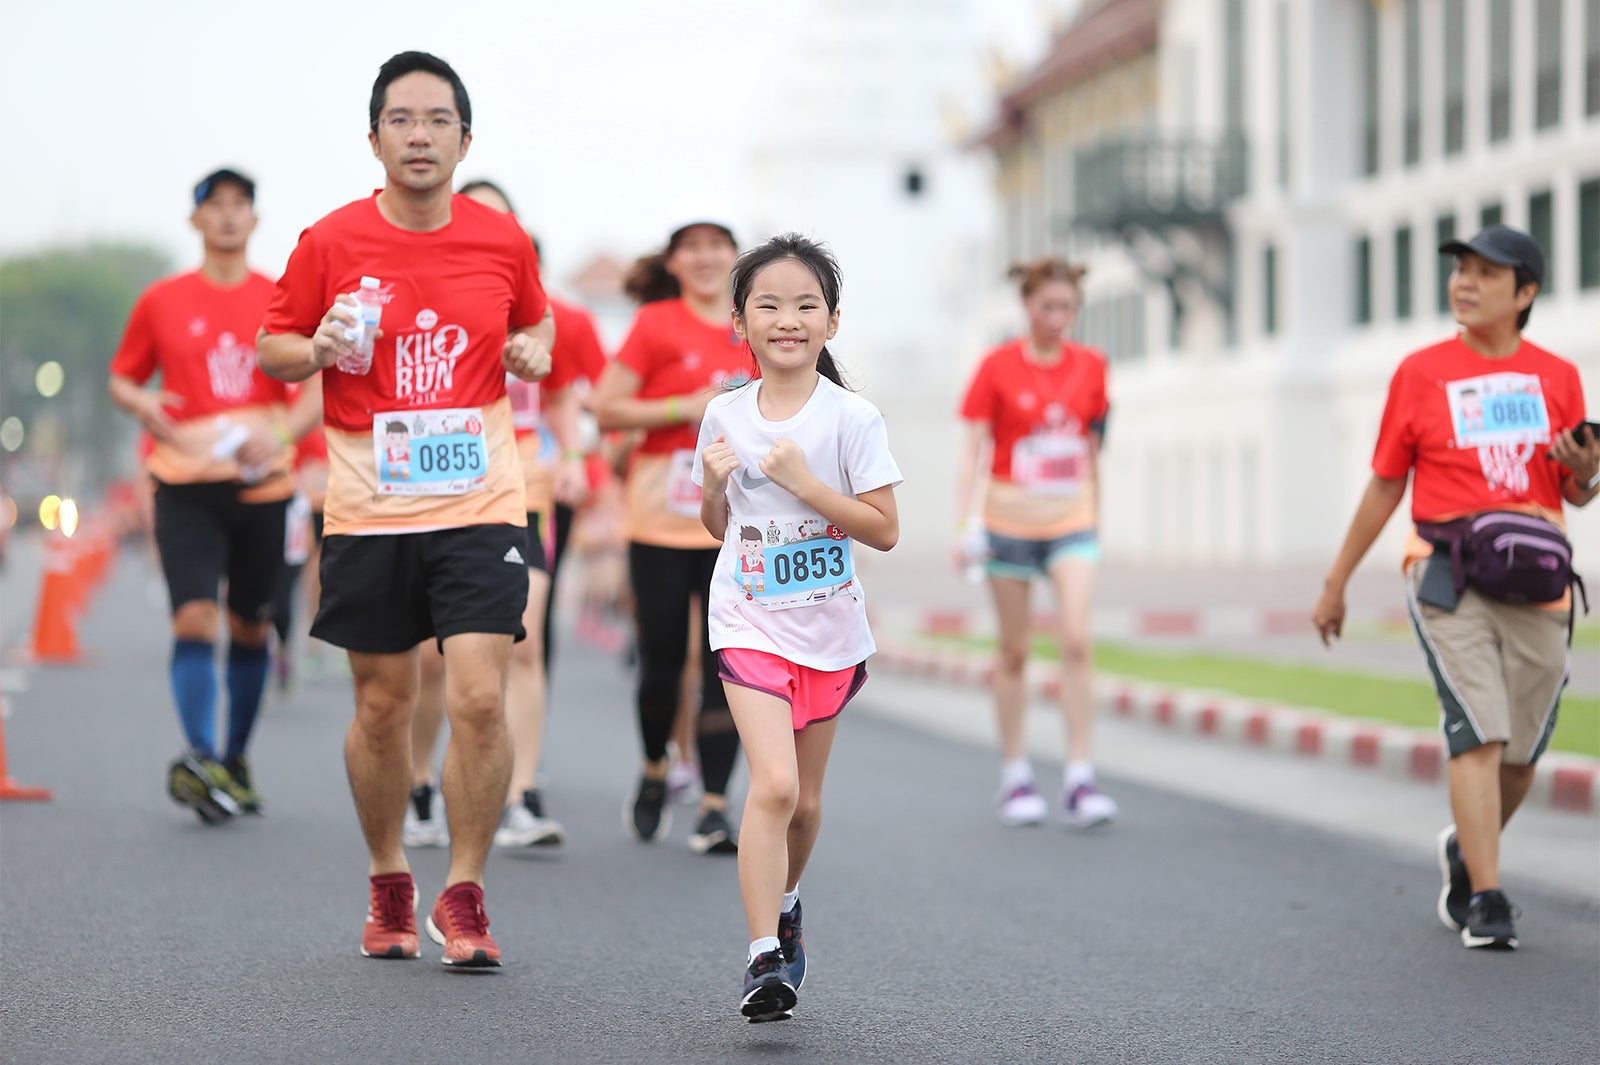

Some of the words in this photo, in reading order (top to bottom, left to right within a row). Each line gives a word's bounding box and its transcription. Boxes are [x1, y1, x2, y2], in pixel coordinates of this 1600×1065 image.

[396, 324, 469, 367] KILO
[396, 358, 456, 399] RUN
[1492, 401, 1540, 424] 0861
[420, 443, 480, 472] 0855
[774, 546, 844, 584] 0853
